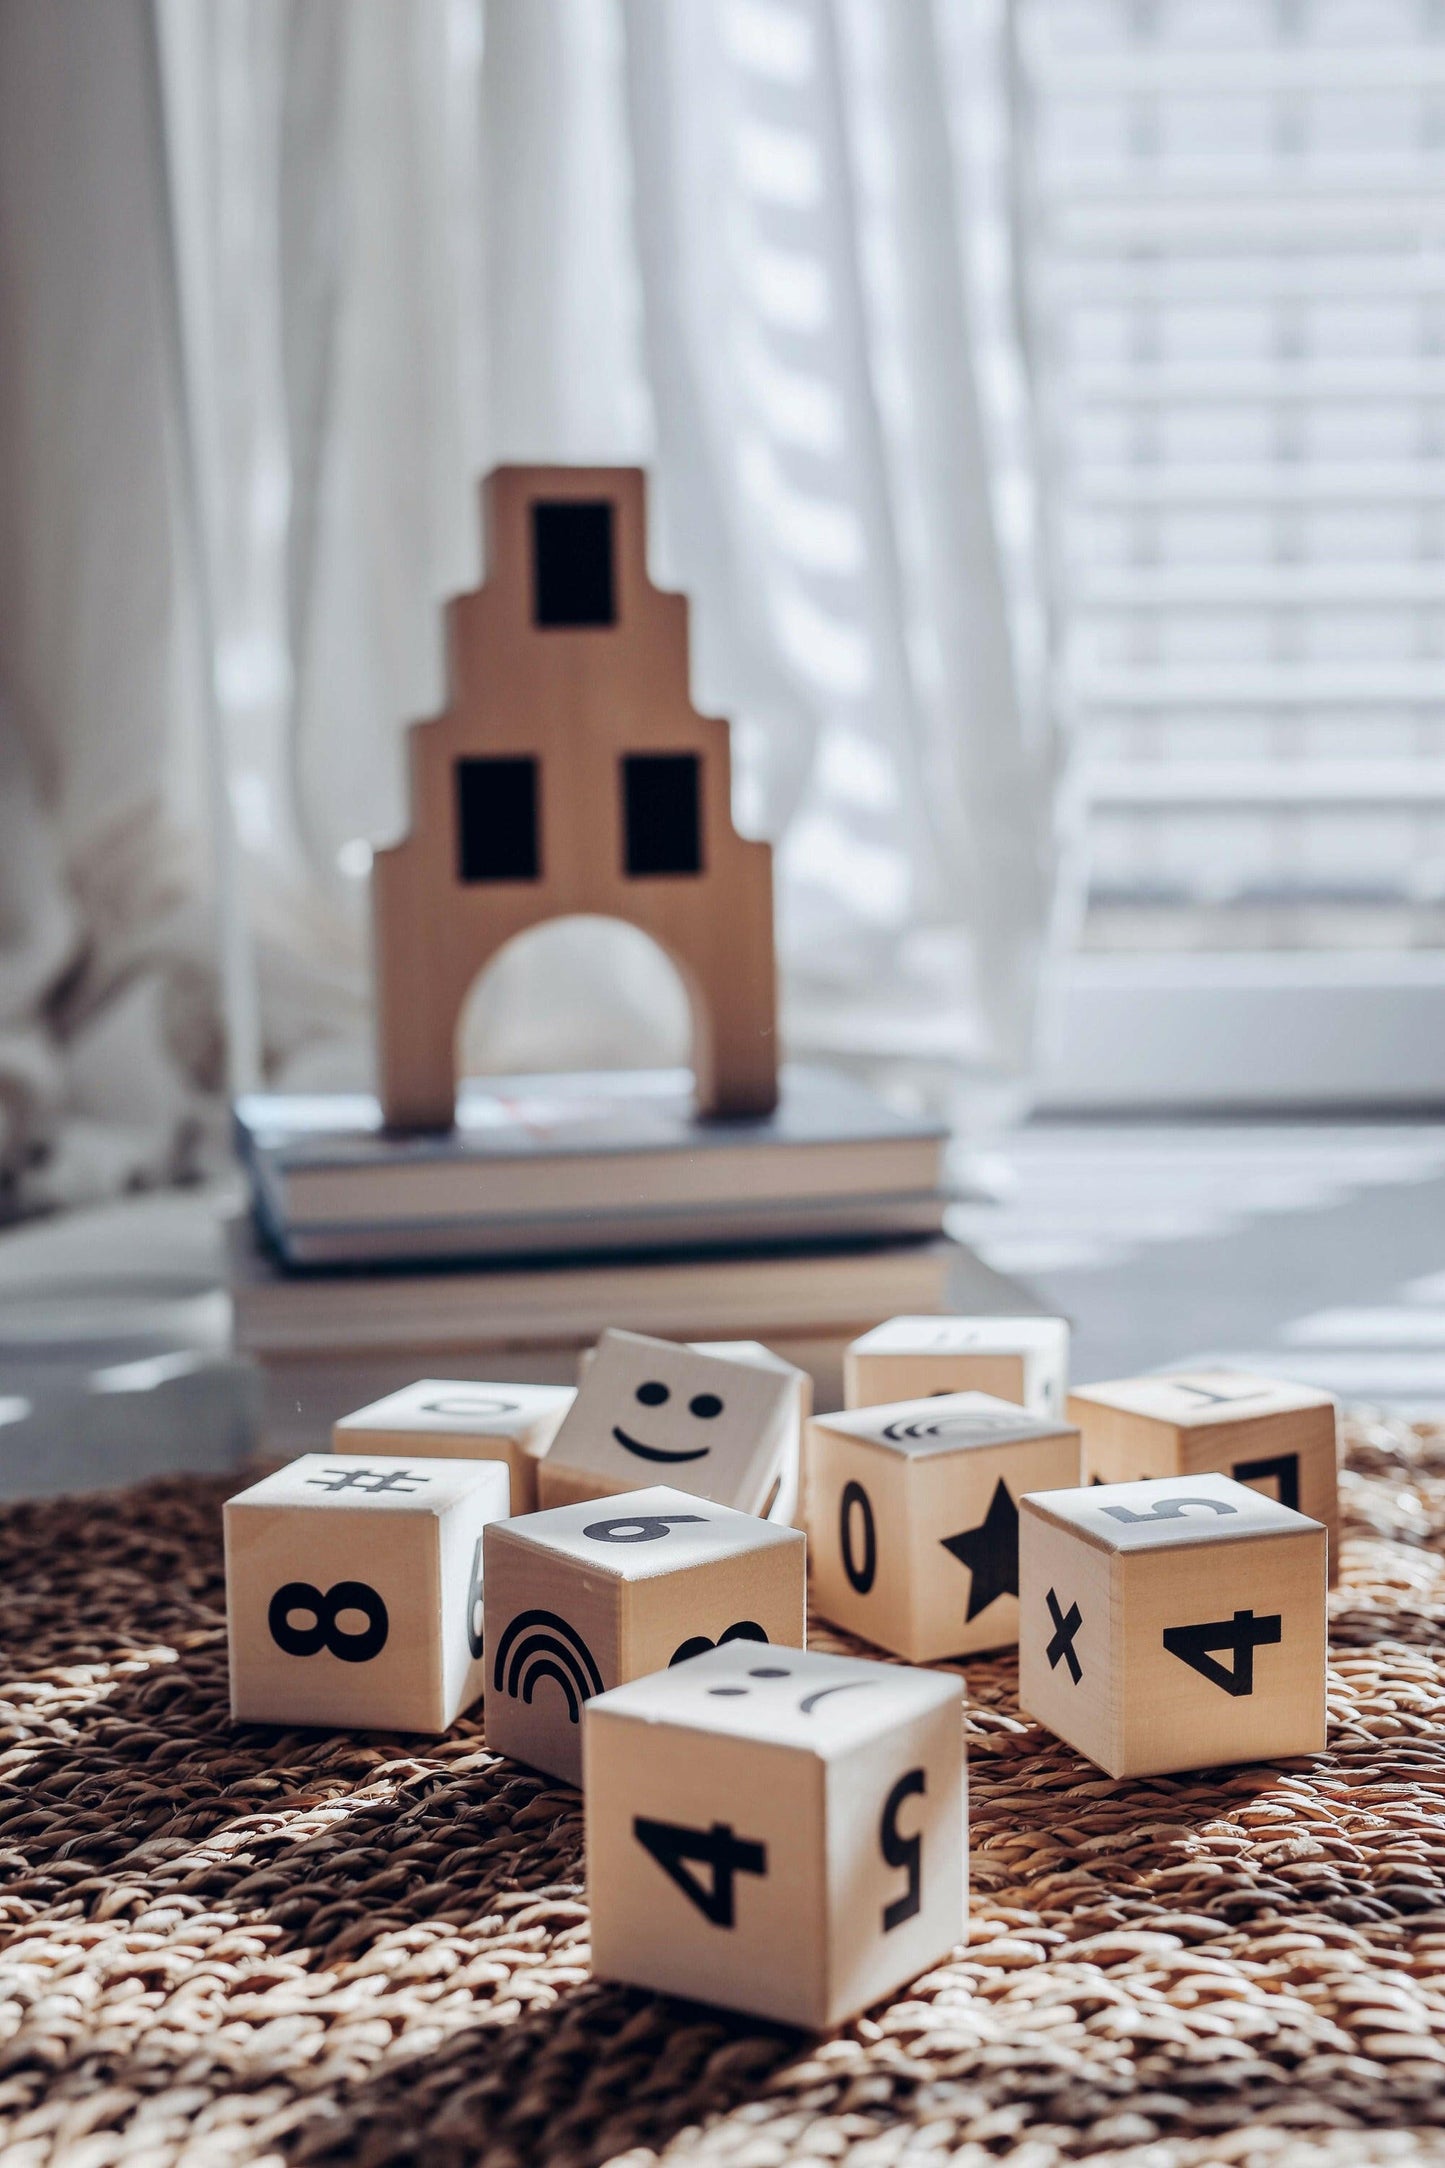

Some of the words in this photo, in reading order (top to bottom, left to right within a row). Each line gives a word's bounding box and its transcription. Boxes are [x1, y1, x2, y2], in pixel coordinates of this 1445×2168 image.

[1098, 1497, 1238, 1524] 5
[268, 1581, 389, 1663] 8
[1163, 1609, 1282, 1697] 4
[632, 1814, 769, 1931] 4
[880, 1767, 928, 1933] 5
